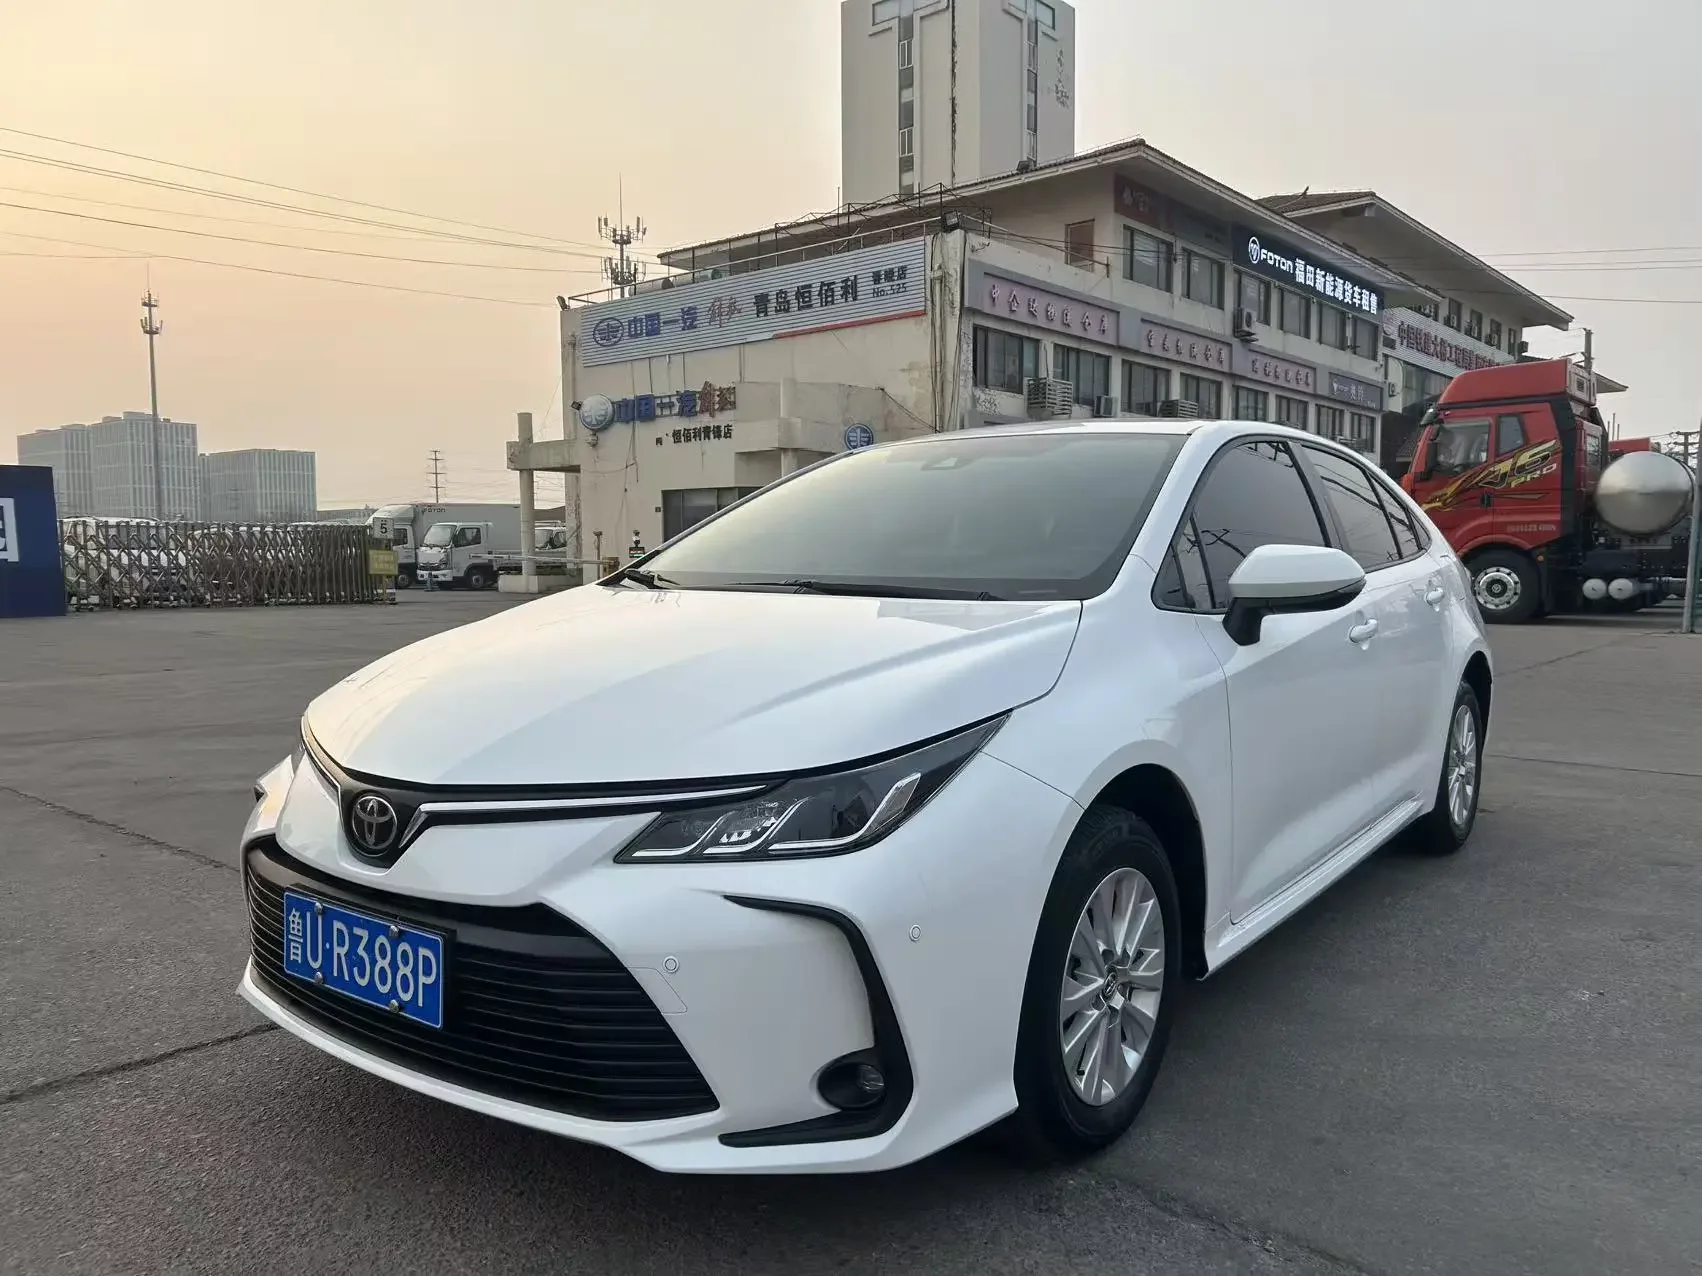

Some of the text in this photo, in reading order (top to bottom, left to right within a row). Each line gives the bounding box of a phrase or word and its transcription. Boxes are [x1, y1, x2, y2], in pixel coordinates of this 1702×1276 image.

[1260, 248, 1294, 274] FOTON
[627, 305, 698, 339] 中国一汽
[753, 275, 858, 318] 青岛恒佰利
[379, 522, 388, 535] 5
[288, 907, 437, 1007] 鲁U·R388P
